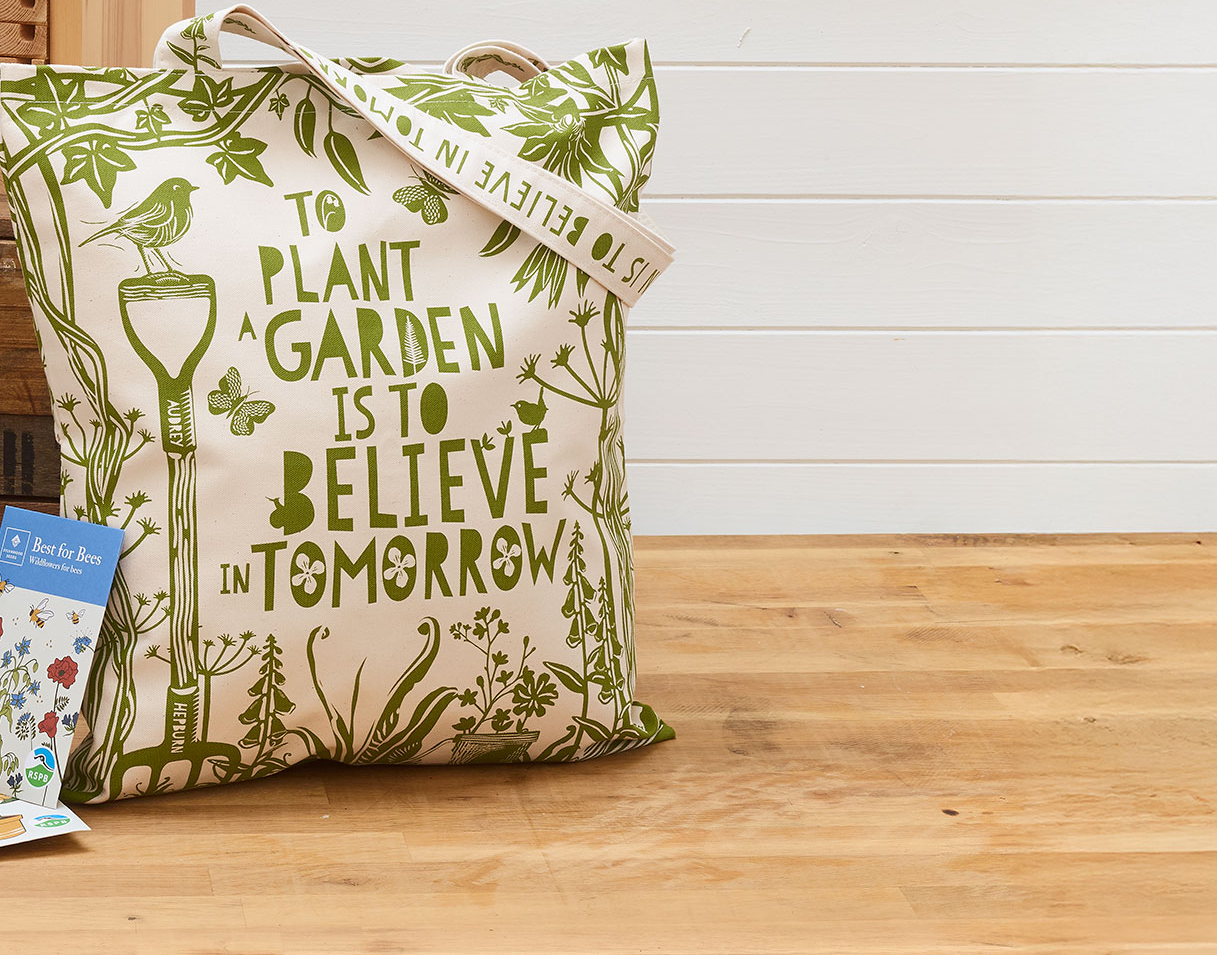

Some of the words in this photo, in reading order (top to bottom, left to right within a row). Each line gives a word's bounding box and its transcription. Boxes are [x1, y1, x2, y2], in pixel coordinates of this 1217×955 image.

[435, 139, 470, 175] IN
[283, 190, 347, 237] TO
[474, 160, 590, 247] BELIEVE
[258, 240, 421, 305] PLANT
[591, 232, 626, 274] TO
[621, 257, 650, 288] IS
[238, 311, 257, 341] A
[265, 302, 505, 382] GARDEN
[167, 399, 184, 447] AUDREY
[332, 385, 376, 442] IS
[388, 382, 449, 438] TO
[269, 428, 549, 536] BELIEVE
[29, 555, 61, 571] Wildflowers
[60, 563, 70, 572] for
[69, 565, 82, 575] bees
[32, 536, 56, 556] Best
[57, 543, 75, 560] for
[76, 546, 102, 566] Bees
[220, 563, 250, 595] IN
[250, 518, 567, 612] TOMORROW
[170, 702, 187, 754] HEPBURN
[28, 770, 49, 783] RSPB
